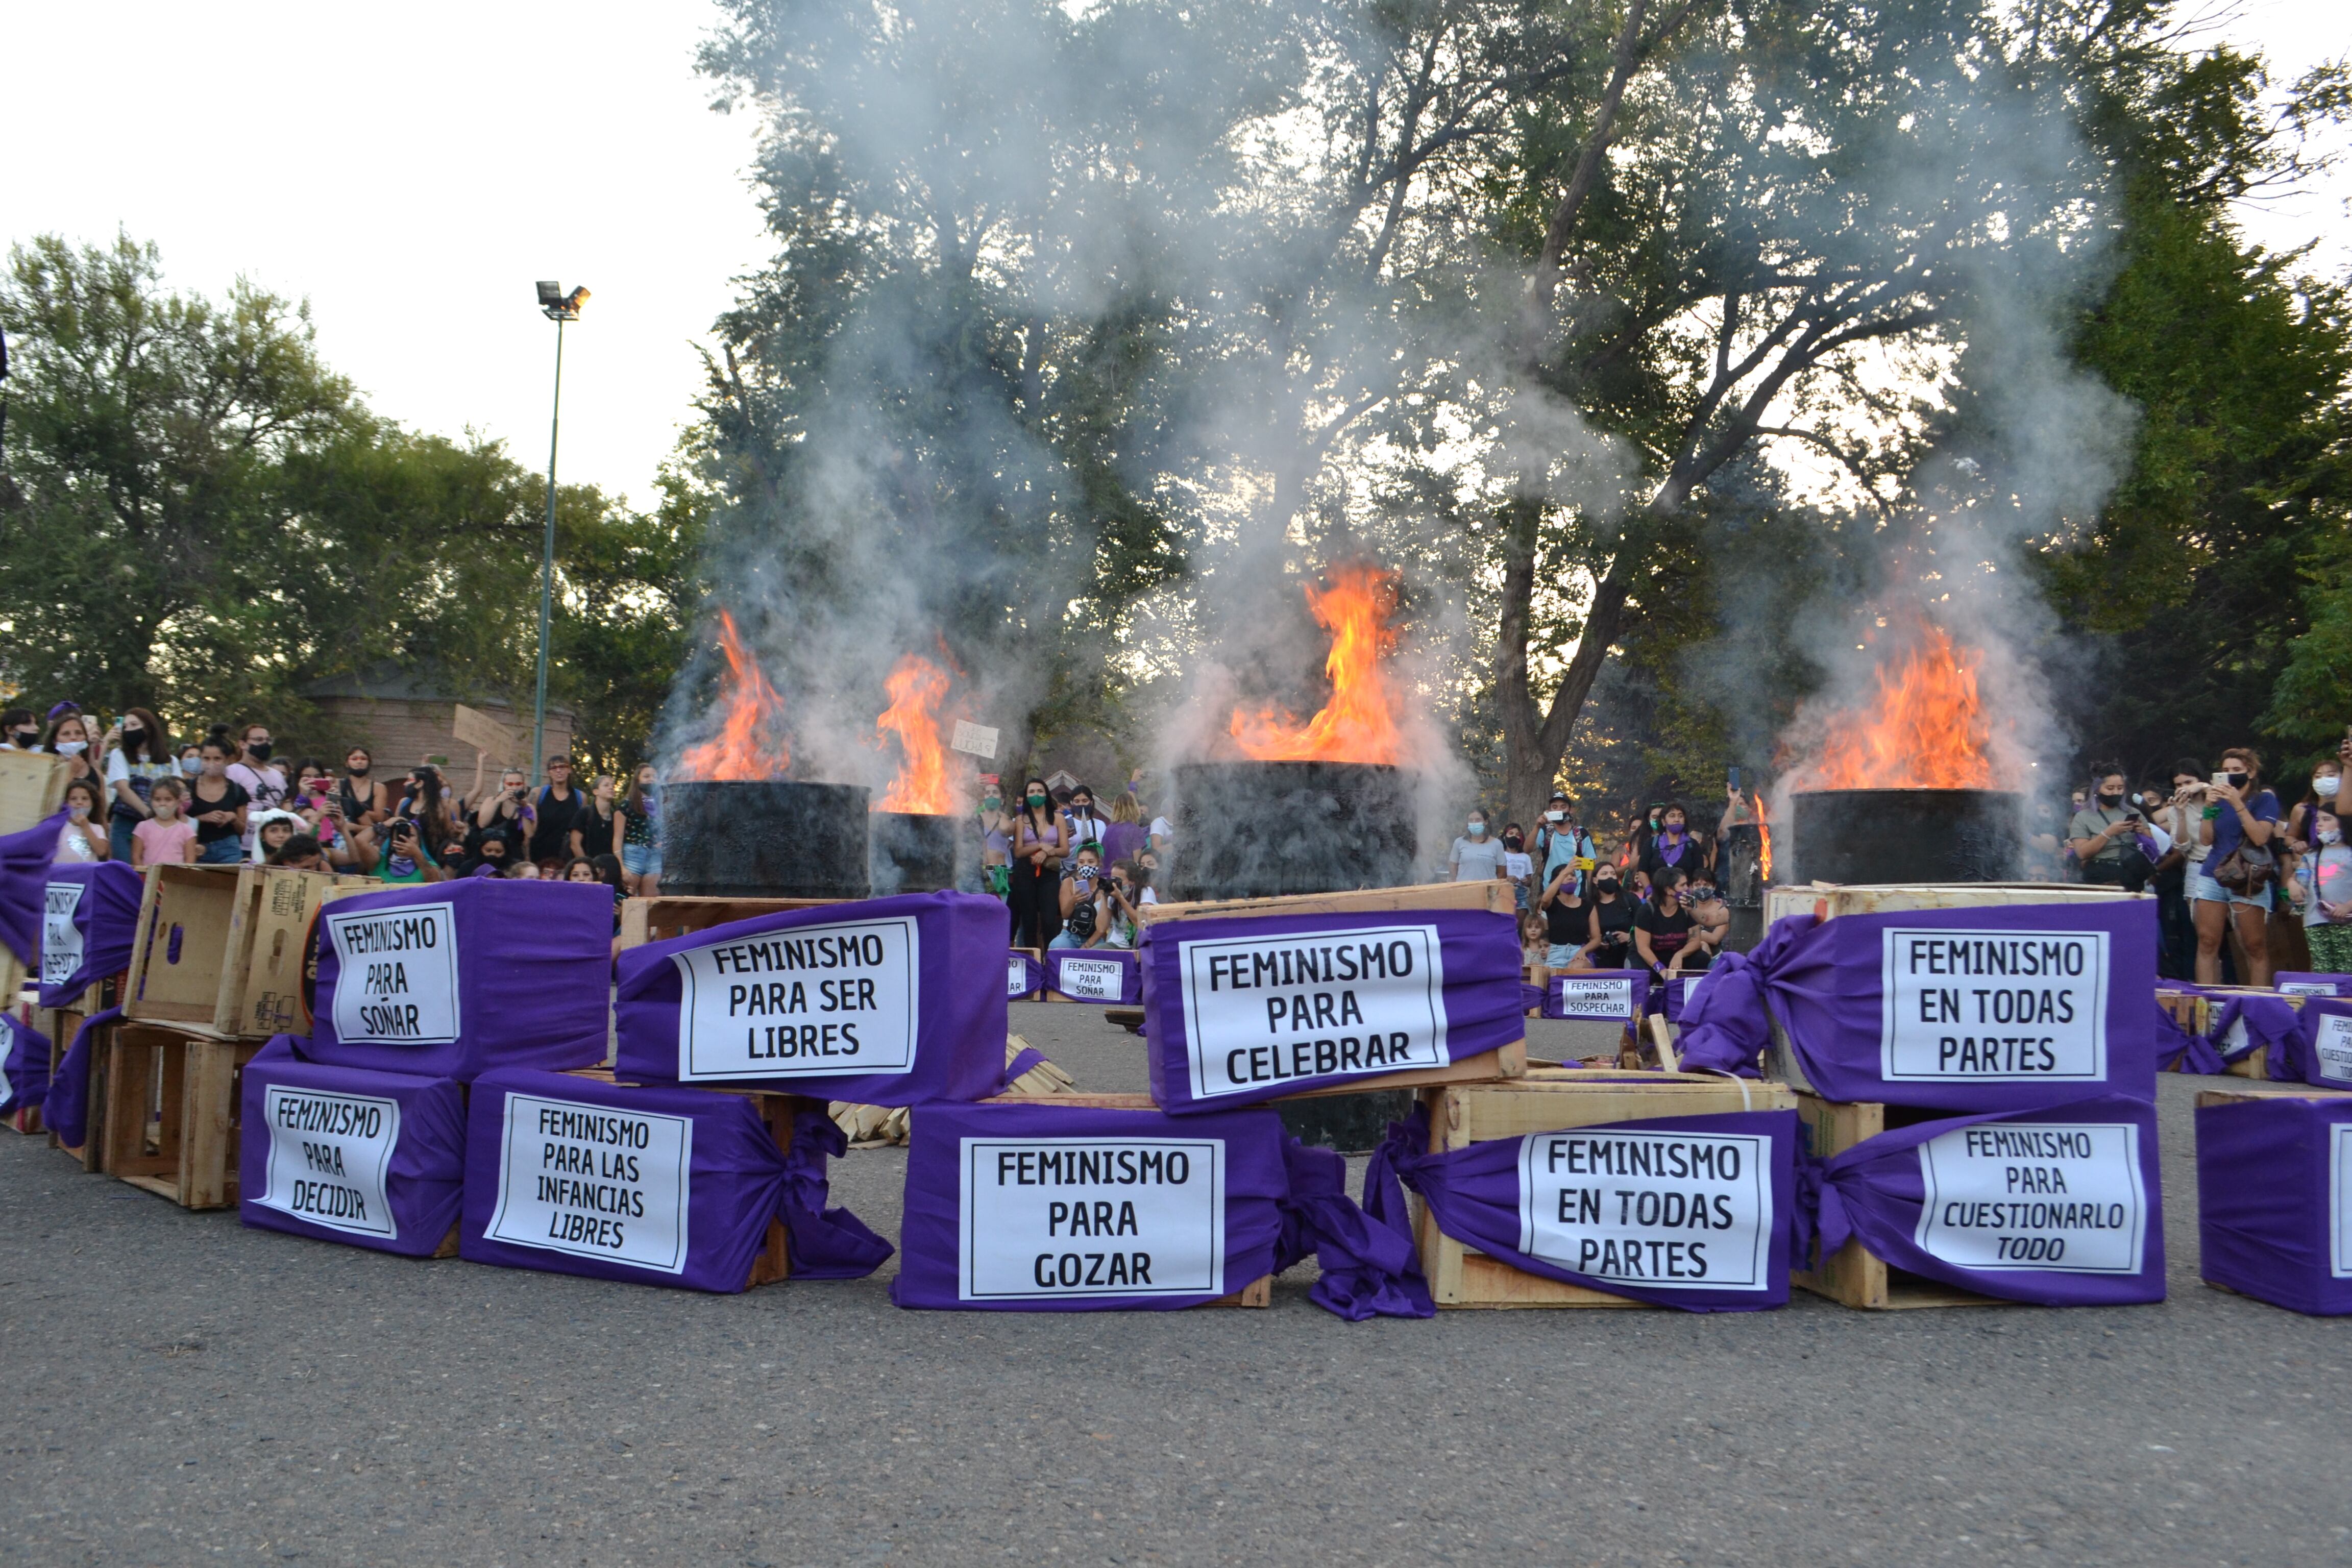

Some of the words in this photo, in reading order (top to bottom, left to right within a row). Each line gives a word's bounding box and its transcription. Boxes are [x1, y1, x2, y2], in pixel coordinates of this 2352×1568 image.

[343, 917, 435, 954] FEMINISMO
[711, 935, 883, 974] FEMINISMO
[1068, 962, 1115, 973] FEMINISMO
[1210, 941, 1412, 991] FEMINISMO
[1911, 941, 2083, 976] FEMINISMO
[365, 962, 408, 994] PARA
[1076, 984, 1104, 996] SOÑAR
[1079, 975, 1101, 985] PARA
[1572, 981, 1622, 990] FEMINISMO
[730, 982, 806, 1016] PARA
[820, 978, 876, 1012] SER
[1267, 990, 1363, 1033] PARA
[1571, 1002, 1624, 1013] SOSPECHAR
[1921, 989, 1959, 1023] EN
[1973, 989, 2073, 1023] TODAS
[360, 997, 420, 1035] SOÑAR
[749, 1023, 859, 1059] LIBRES
[1227, 1032, 1411, 1083] CELEBRAR
[1940, 1037, 2054, 1071] PARTES
[278, 1098, 380, 1138] FEMINISMO
[540, 1109, 648, 1149] FEMINISMO
[303, 1142, 346, 1178] PARA
[544, 1143, 594, 1175] PARA
[602, 1152, 639, 1182] LAS
[1549, 1140, 1739, 1180] FEMINISMO
[1966, 1131, 2090, 1158] FEMINISMO
[999, 1151, 1189, 1185] FEMINISMO
[2006, 1167, 2067, 1193] PARA
[292, 1180, 366, 1220] DECIDIR
[537, 1175, 643, 1217] INFANCIAS
[1559, 1189, 1600, 1224] EN
[1615, 1191, 1732, 1230] TODAS
[549, 1212, 623, 1248] LIBRES
[1050, 1201, 1138, 1236] PARA
[1944, 1202, 2123, 1229] CUESTIONARLO
[1579, 1239, 1707, 1278] PARTES
[1998, 1237, 2064, 1261] TODO
[1035, 1253, 1152, 1287] GOZAR
